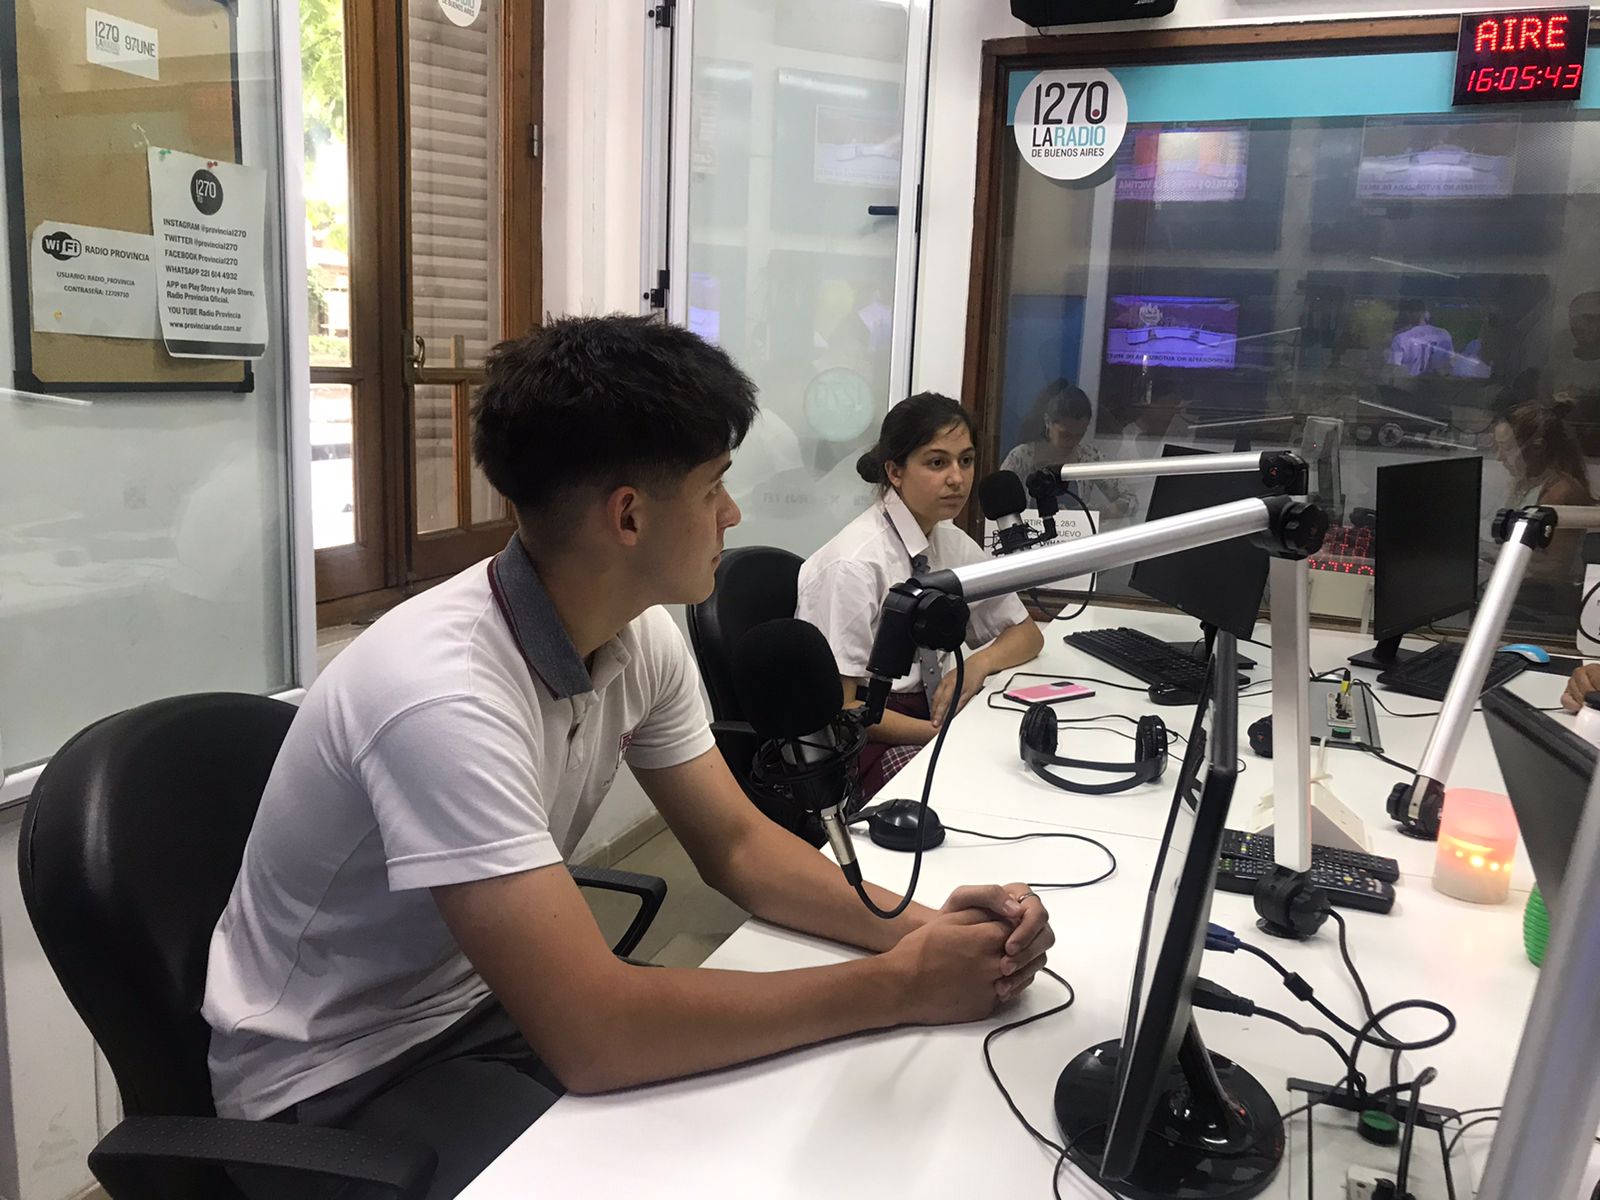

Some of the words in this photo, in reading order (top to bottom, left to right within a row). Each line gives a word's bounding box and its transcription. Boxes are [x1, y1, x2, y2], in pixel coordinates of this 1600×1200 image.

[95, 20, 120, 43] 1270
[1475, 15, 1568, 52] AIRE
[1467, 64, 1582, 92] 16:05:43
[1033, 81, 1109, 125] 1270
[1032, 148, 1042, 157] DE
[1044, 148, 1078, 157] BUENOS
[1080, 147, 1104, 157] AIRES
[195, 179, 216, 198] 1270
[163, 218, 200, 230] INSTAGRAM
[164, 233, 193, 245] TWITTER
[85, 245, 108, 256] RADIO
[110, 249, 150, 261] PROVINCIA
[165, 249, 198, 260] FACEBOOK
[165, 265, 199, 275] WHATSAPP
[200, 269, 210, 277] 221
[166, 281, 179, 289] APP
[188, 283, 199, 292] Play
[220, 286, 236, 295] Apple
[166, 291, 183, 299] Radio
[184, 292, 209, 302] Provincia
[168, 306, 181, 314] YOU
[182, 307, 197, 316] TUBE
[199, 308, 215, 317] Radio
[215, 310, 241, 319] Provincia
